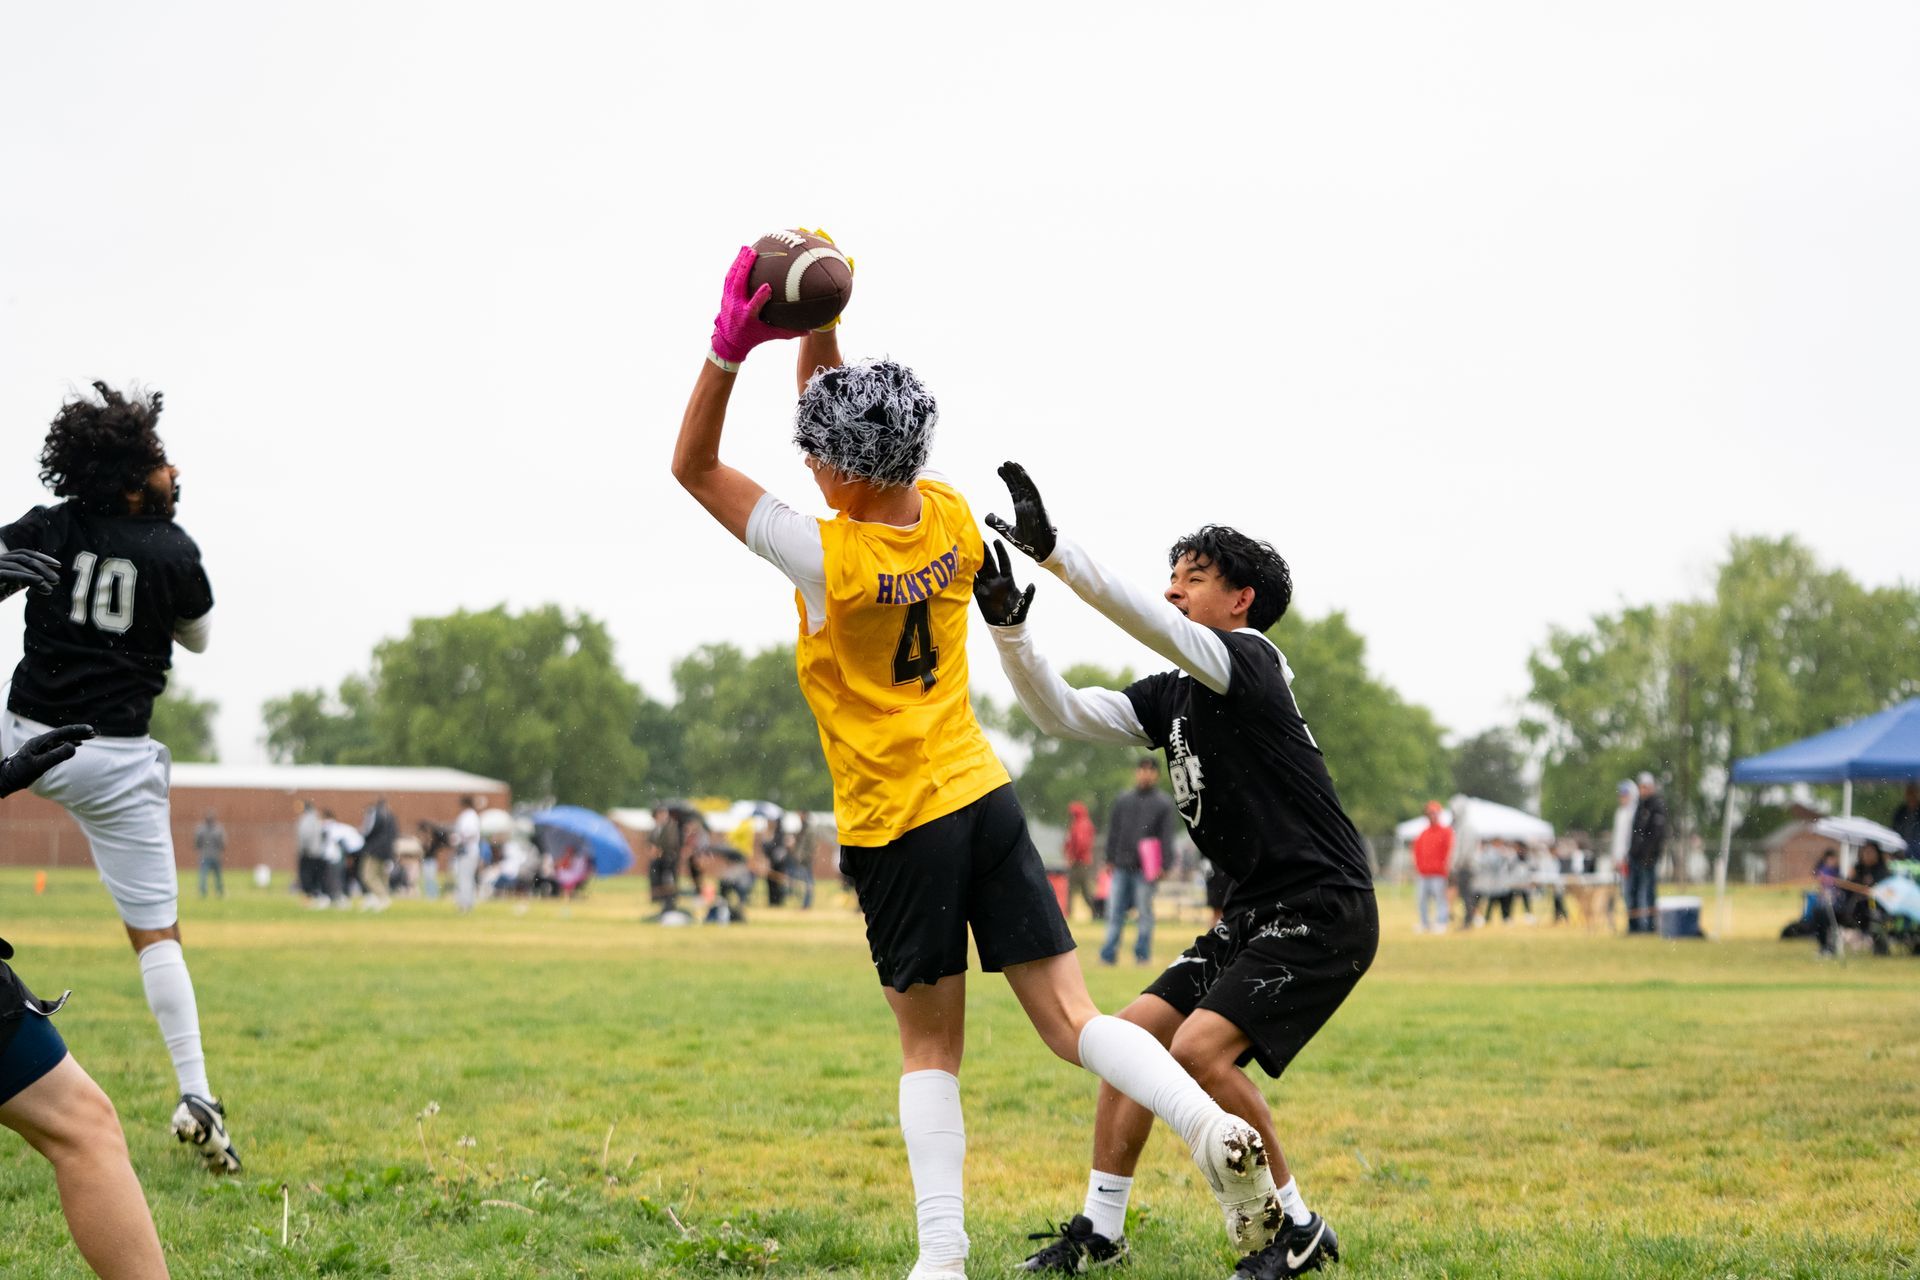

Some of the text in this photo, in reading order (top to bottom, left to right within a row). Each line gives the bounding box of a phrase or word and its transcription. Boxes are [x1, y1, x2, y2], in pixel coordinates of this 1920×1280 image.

[70, 550, 138, 633] 10
[876, 544, 959, 604] HANFOR
[891, 598, 940, 696] 4
